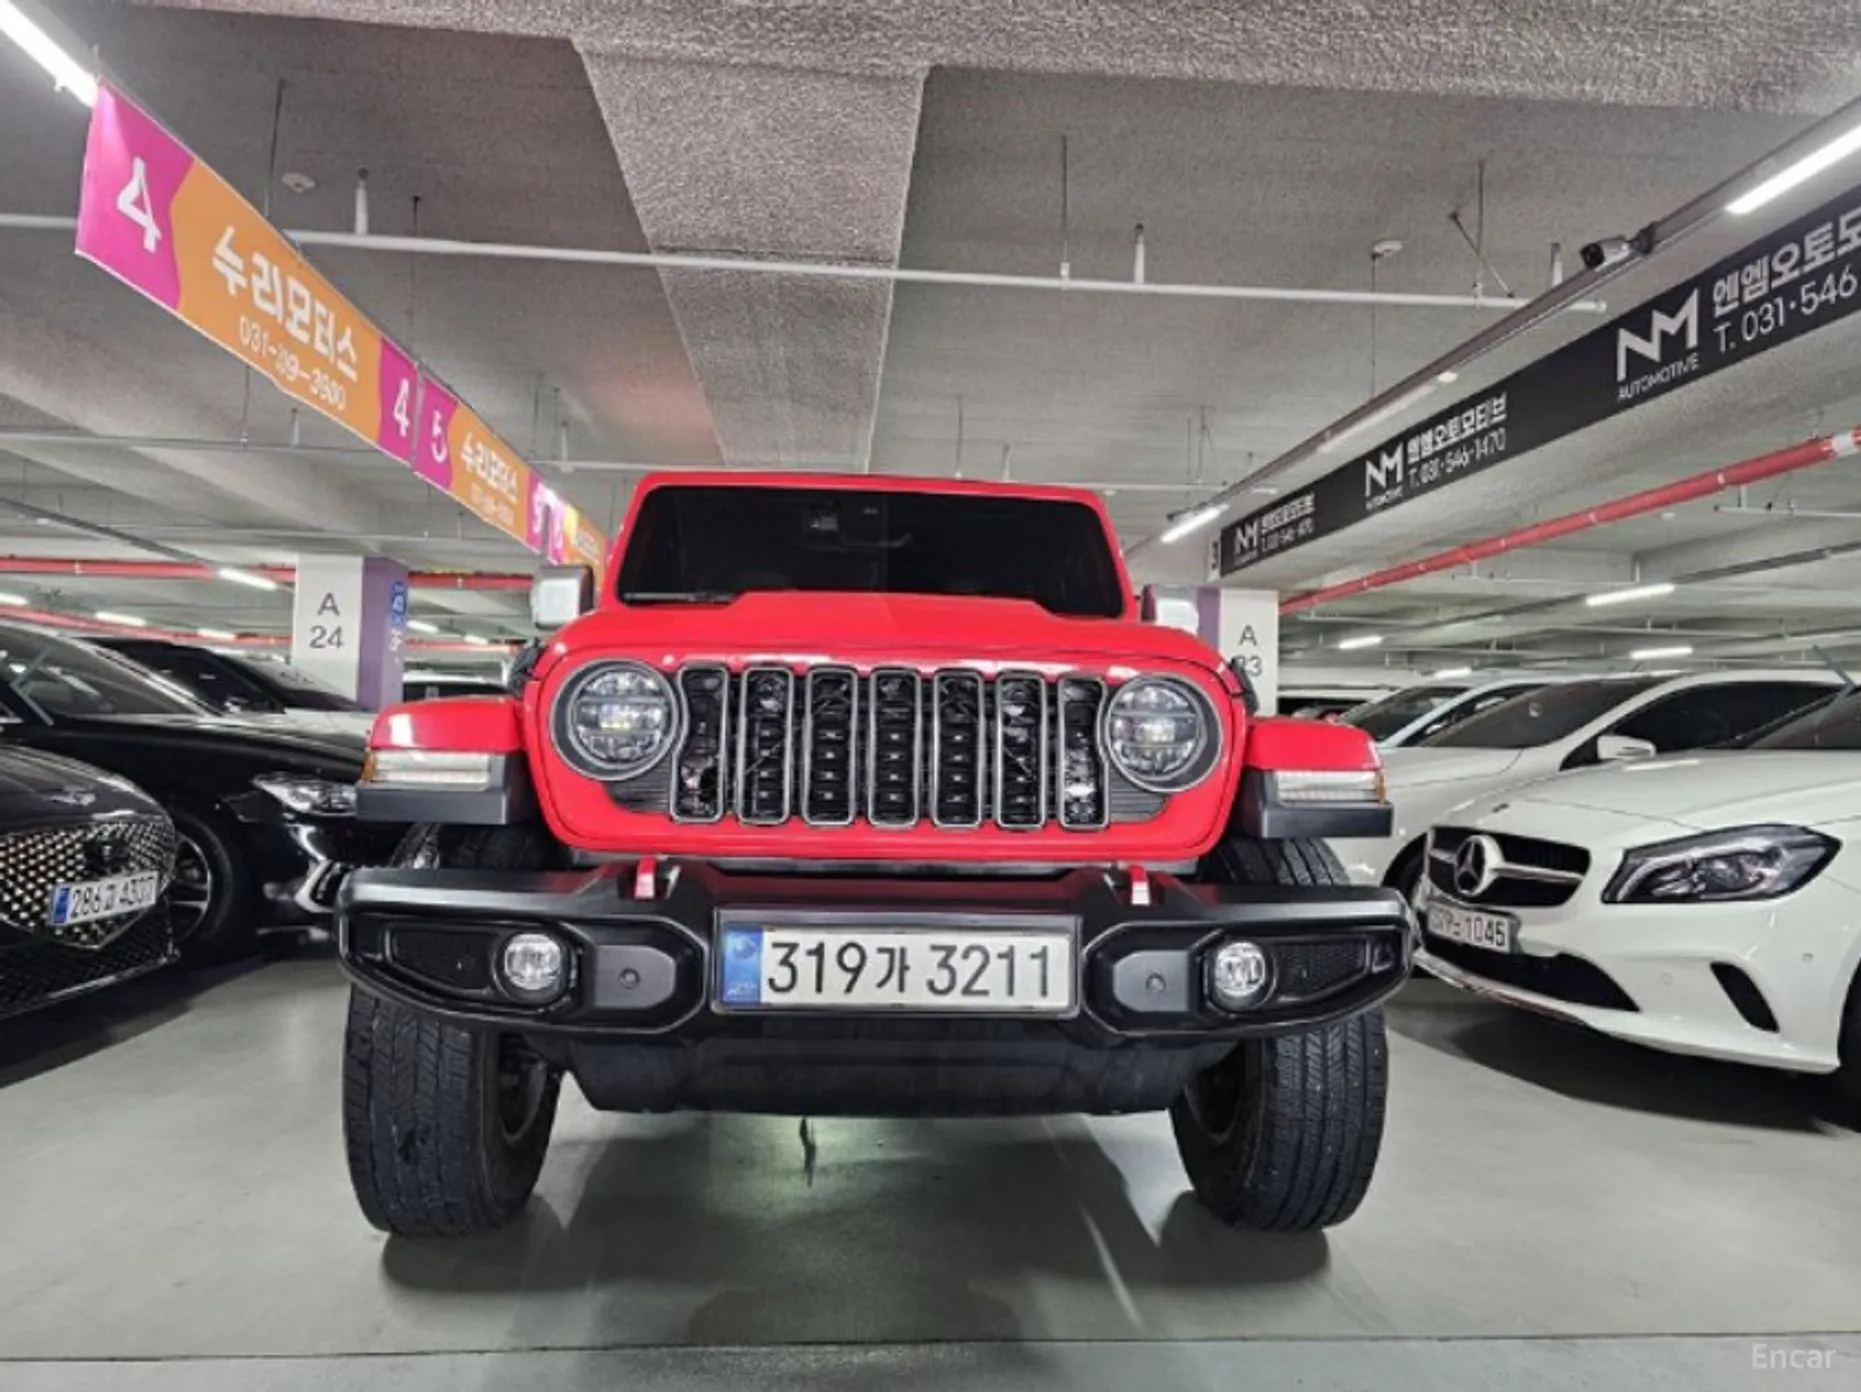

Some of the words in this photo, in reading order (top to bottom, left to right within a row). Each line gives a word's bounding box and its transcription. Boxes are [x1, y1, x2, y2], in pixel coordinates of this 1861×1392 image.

[116, 156, 162, 254] 4
[212, 225, 358, 382] 누리모터스
[1616, 287, 1700, 383] NM
[1618, 352, 1700, 400] AUTOMOTIVE
[394, 377, 410, 437] 4
[431, 410, 447, 464] 5
[1365, 441, 1404, 497] NM
[317, 591, 341, 616] A
[308, 625, 344, 650] 24
[1238, 624, 1258, 646] A
[1465, 916, 1505, 947] 1045
[767, 941, 910, 994] 319가
[926, 944, 1049, 997] 3211
